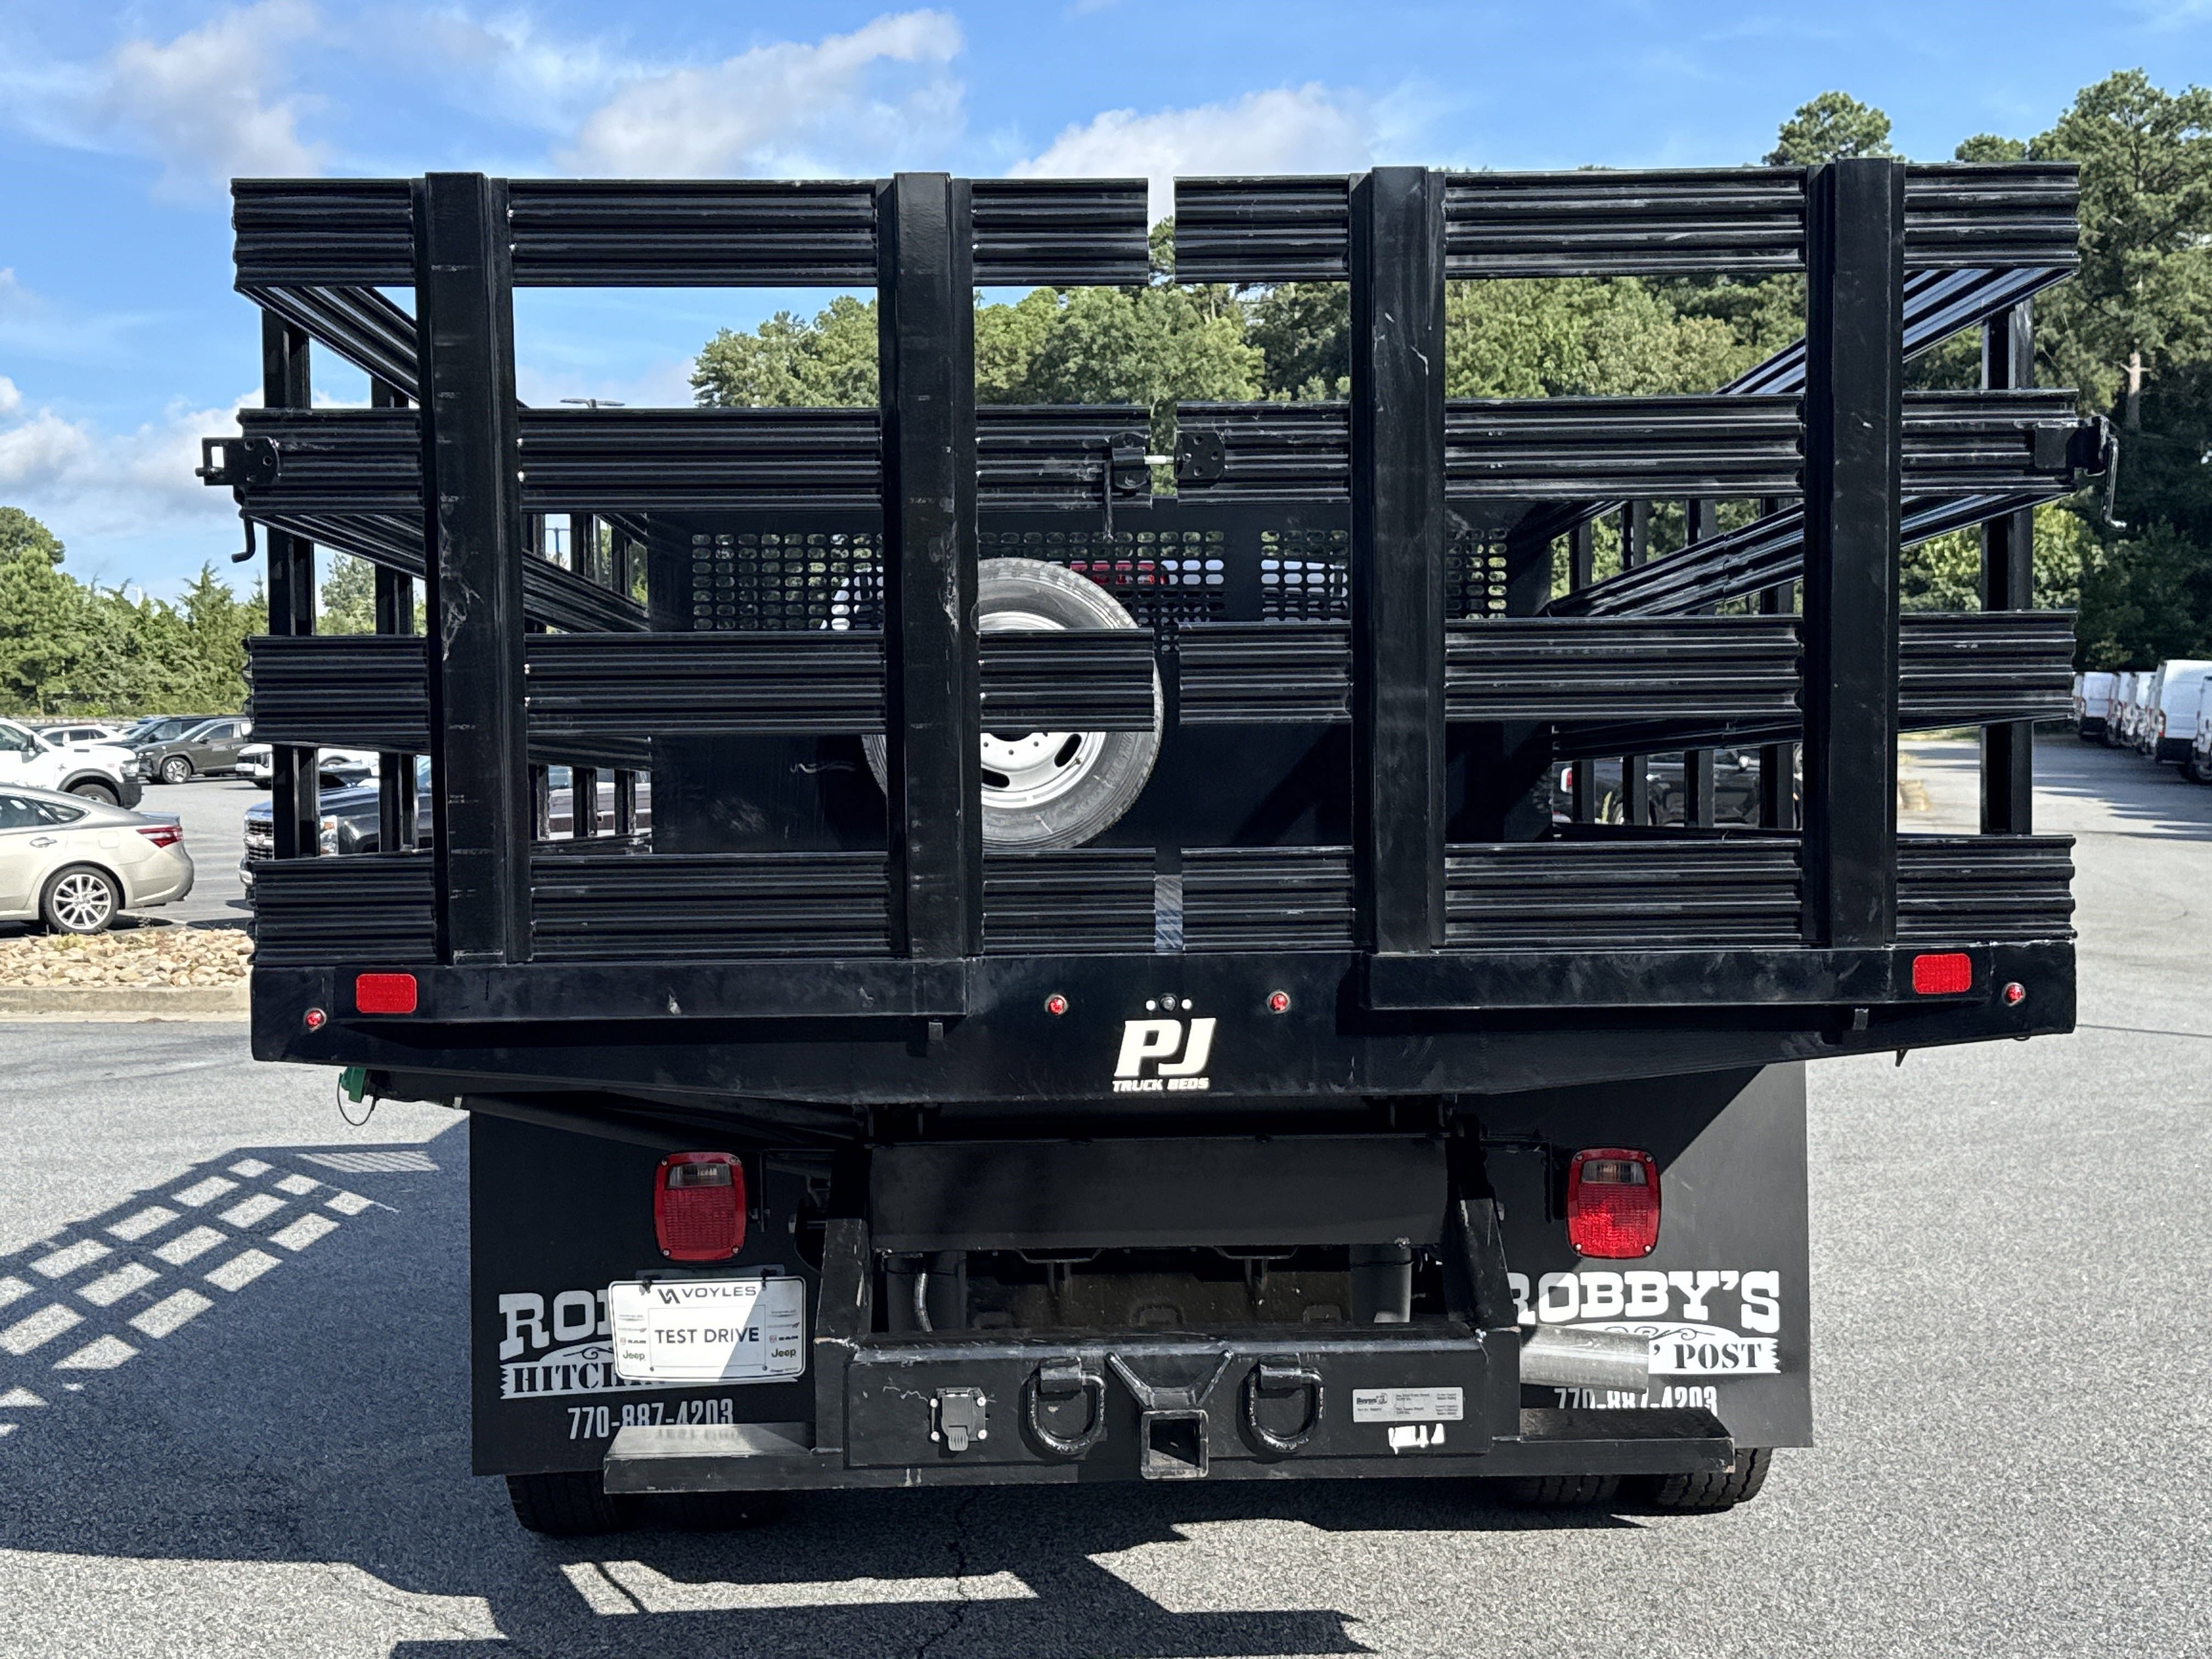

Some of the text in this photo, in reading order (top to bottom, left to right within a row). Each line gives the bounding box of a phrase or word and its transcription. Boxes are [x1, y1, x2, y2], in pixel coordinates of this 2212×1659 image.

[1114, 1018, 1216, 1077] PJ
[1112, 1077, 1209, 1092] TRUCK BEDS
[682, 1286, 757, 1298] VOYLES
[654, 1327, 759, 1344] TEST DRIVE
[623, 1350, 645, 1361] Jeep
[771, 1348, 797, 1358] Jeep
[1673, 1343, 1762, 1369] POST
[567, 1398, 733, 1440] 770-887-4203
